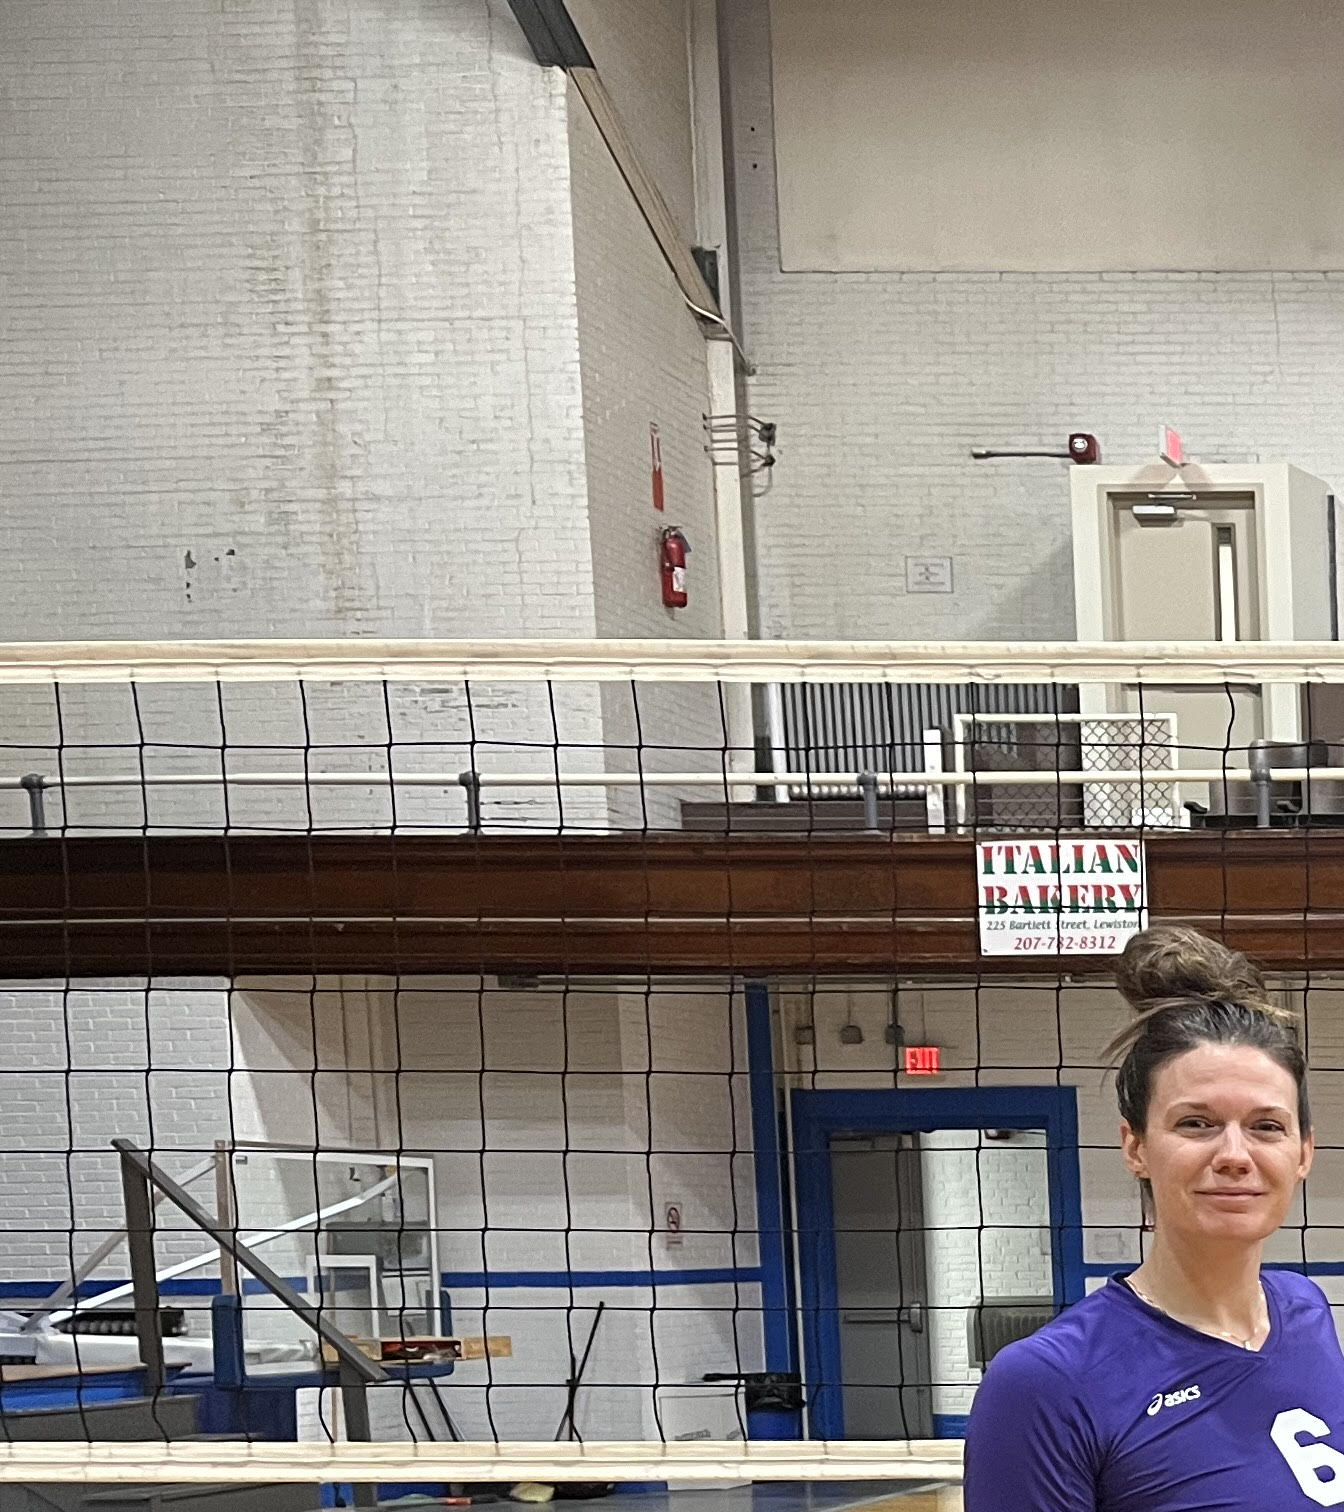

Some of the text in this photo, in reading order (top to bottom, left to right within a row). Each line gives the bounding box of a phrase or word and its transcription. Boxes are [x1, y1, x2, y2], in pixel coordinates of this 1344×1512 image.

[982, 844, 1139, 875] ITALIAN
[983, 884, 1142, 915] BAKERY
[986, 920, 1006, 931] 225
[1009, 919, 1051, 930] Bartlett
[1054, 919, 1090, 931] treet,
[1014, 936, 1116, 950] 207-782-8312
